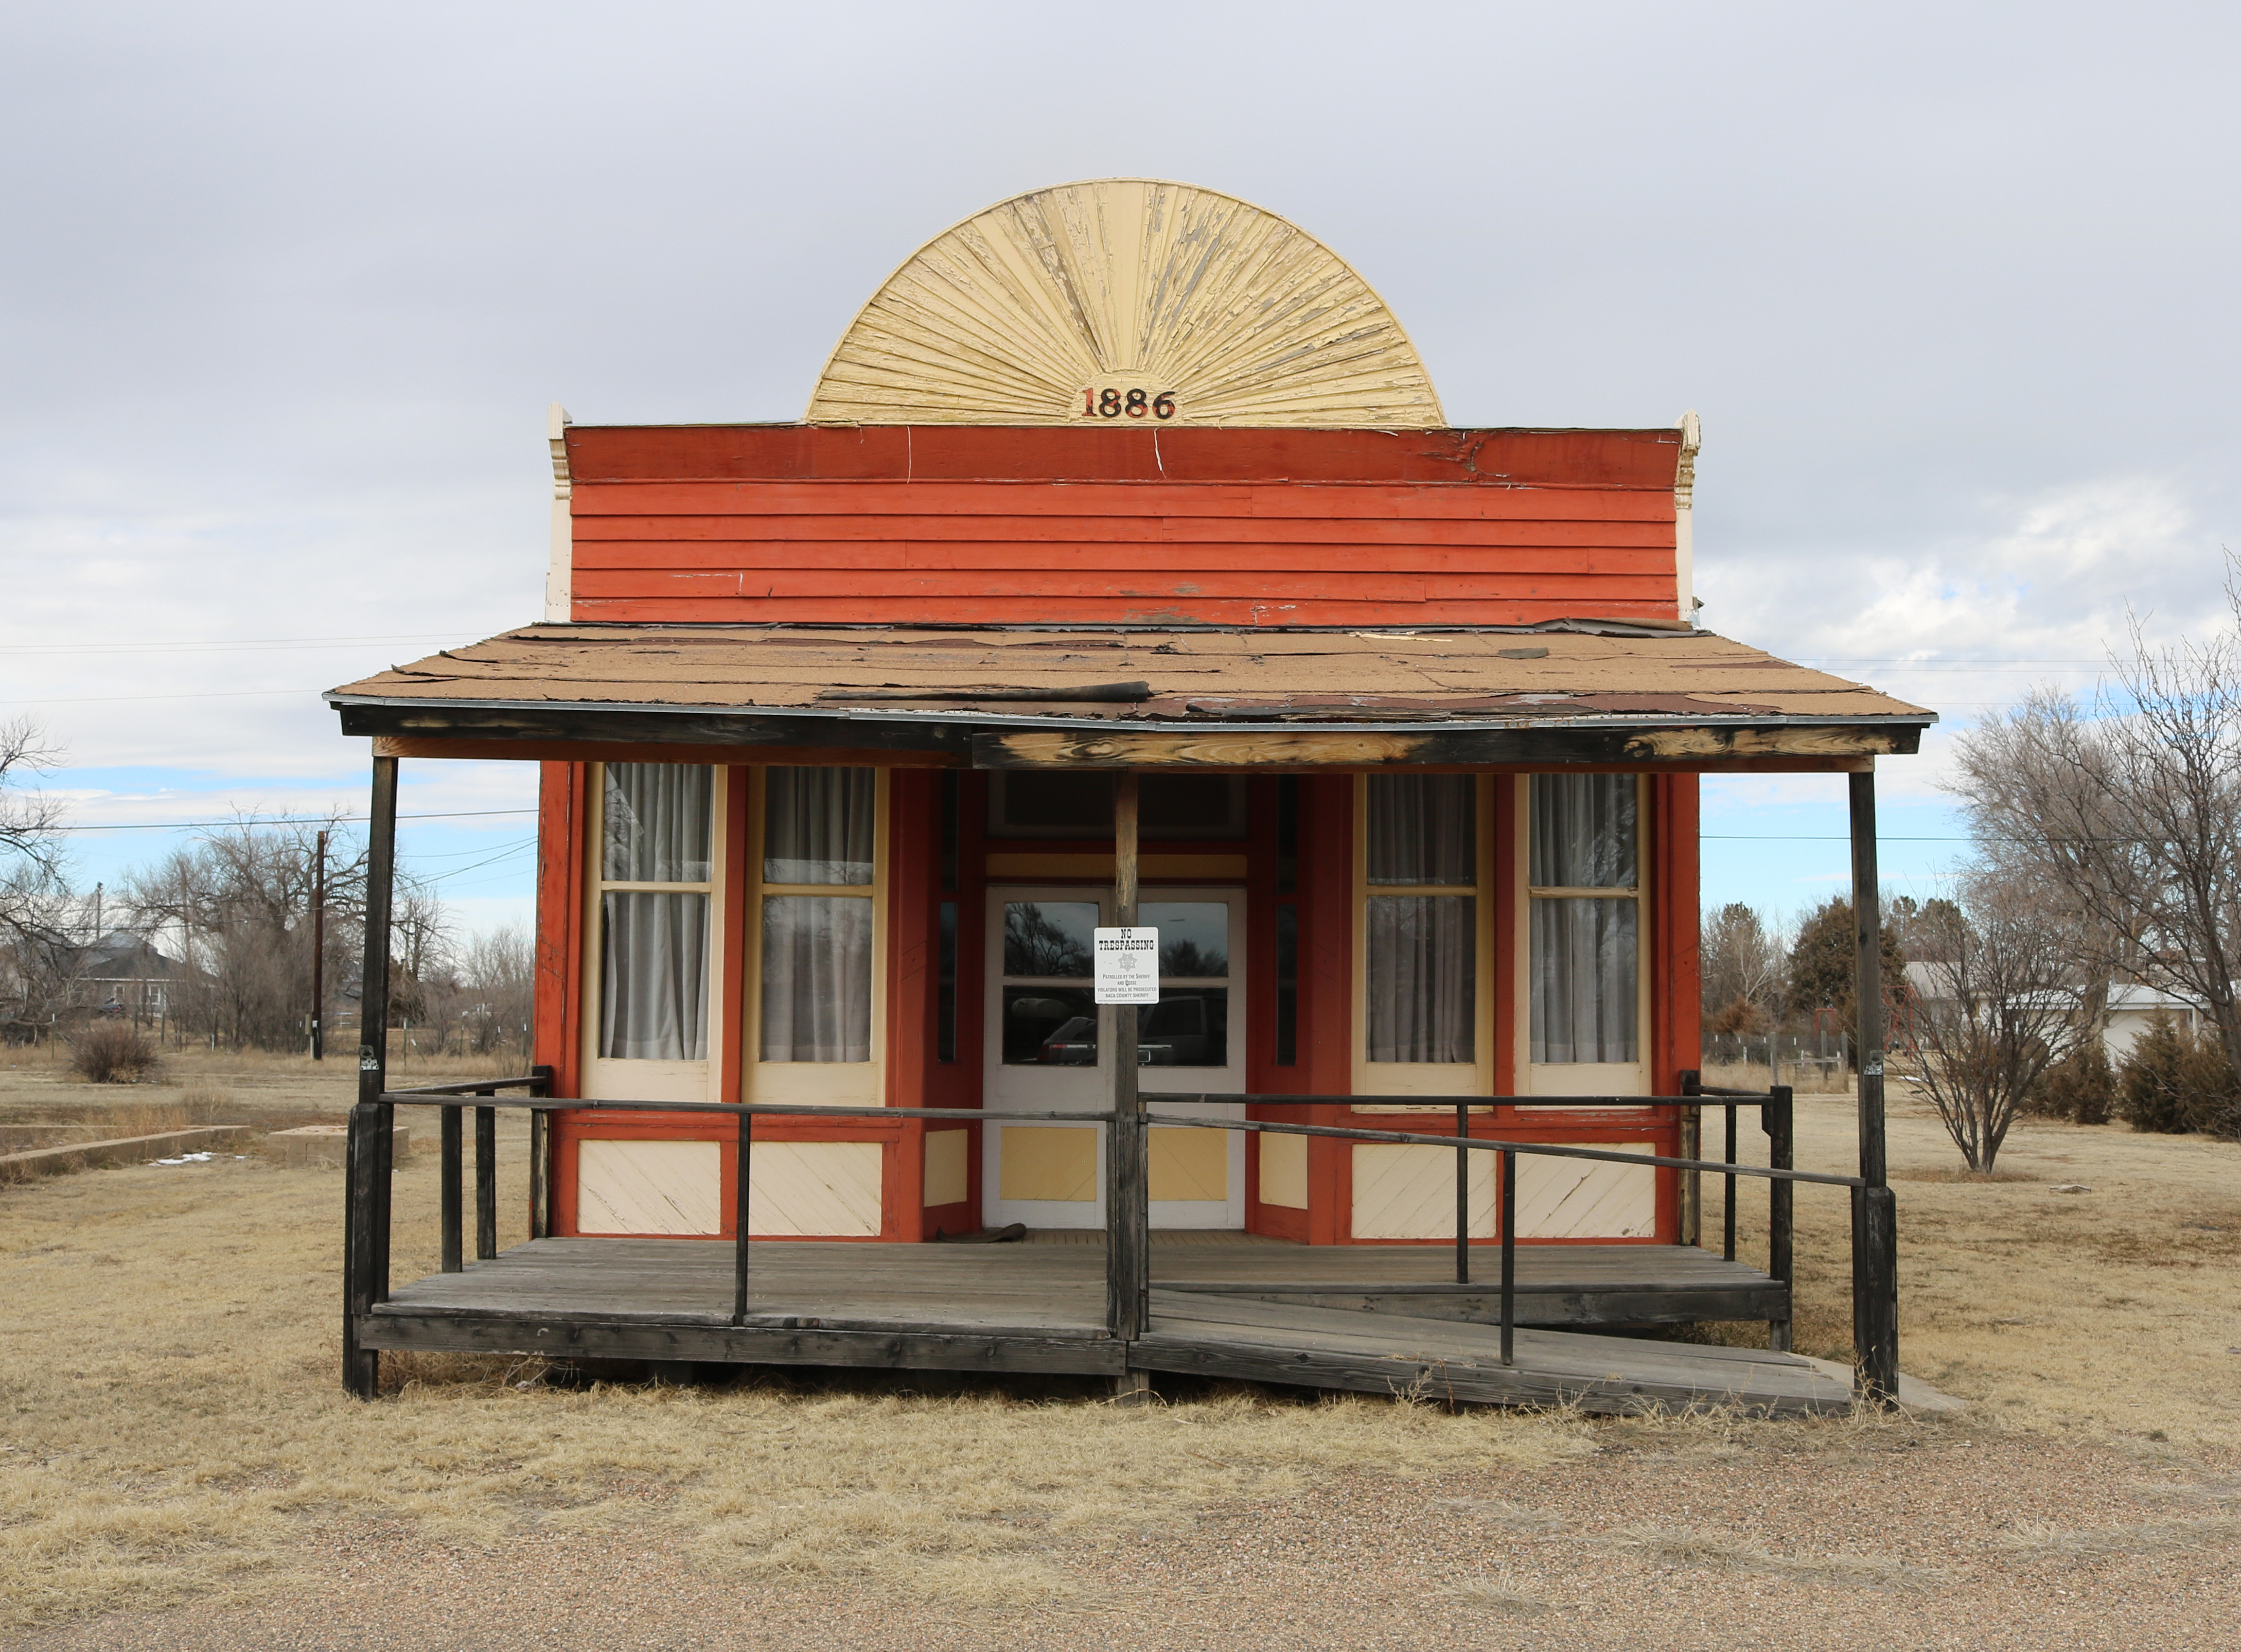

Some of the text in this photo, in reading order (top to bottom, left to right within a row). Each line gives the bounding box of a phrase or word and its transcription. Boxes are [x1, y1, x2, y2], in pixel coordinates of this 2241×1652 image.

[1081, 387, 1176, 420] 1886
[1121, 929, 1132, 939] NO
[1098, 940, 1154, 950] TRESPASSING
